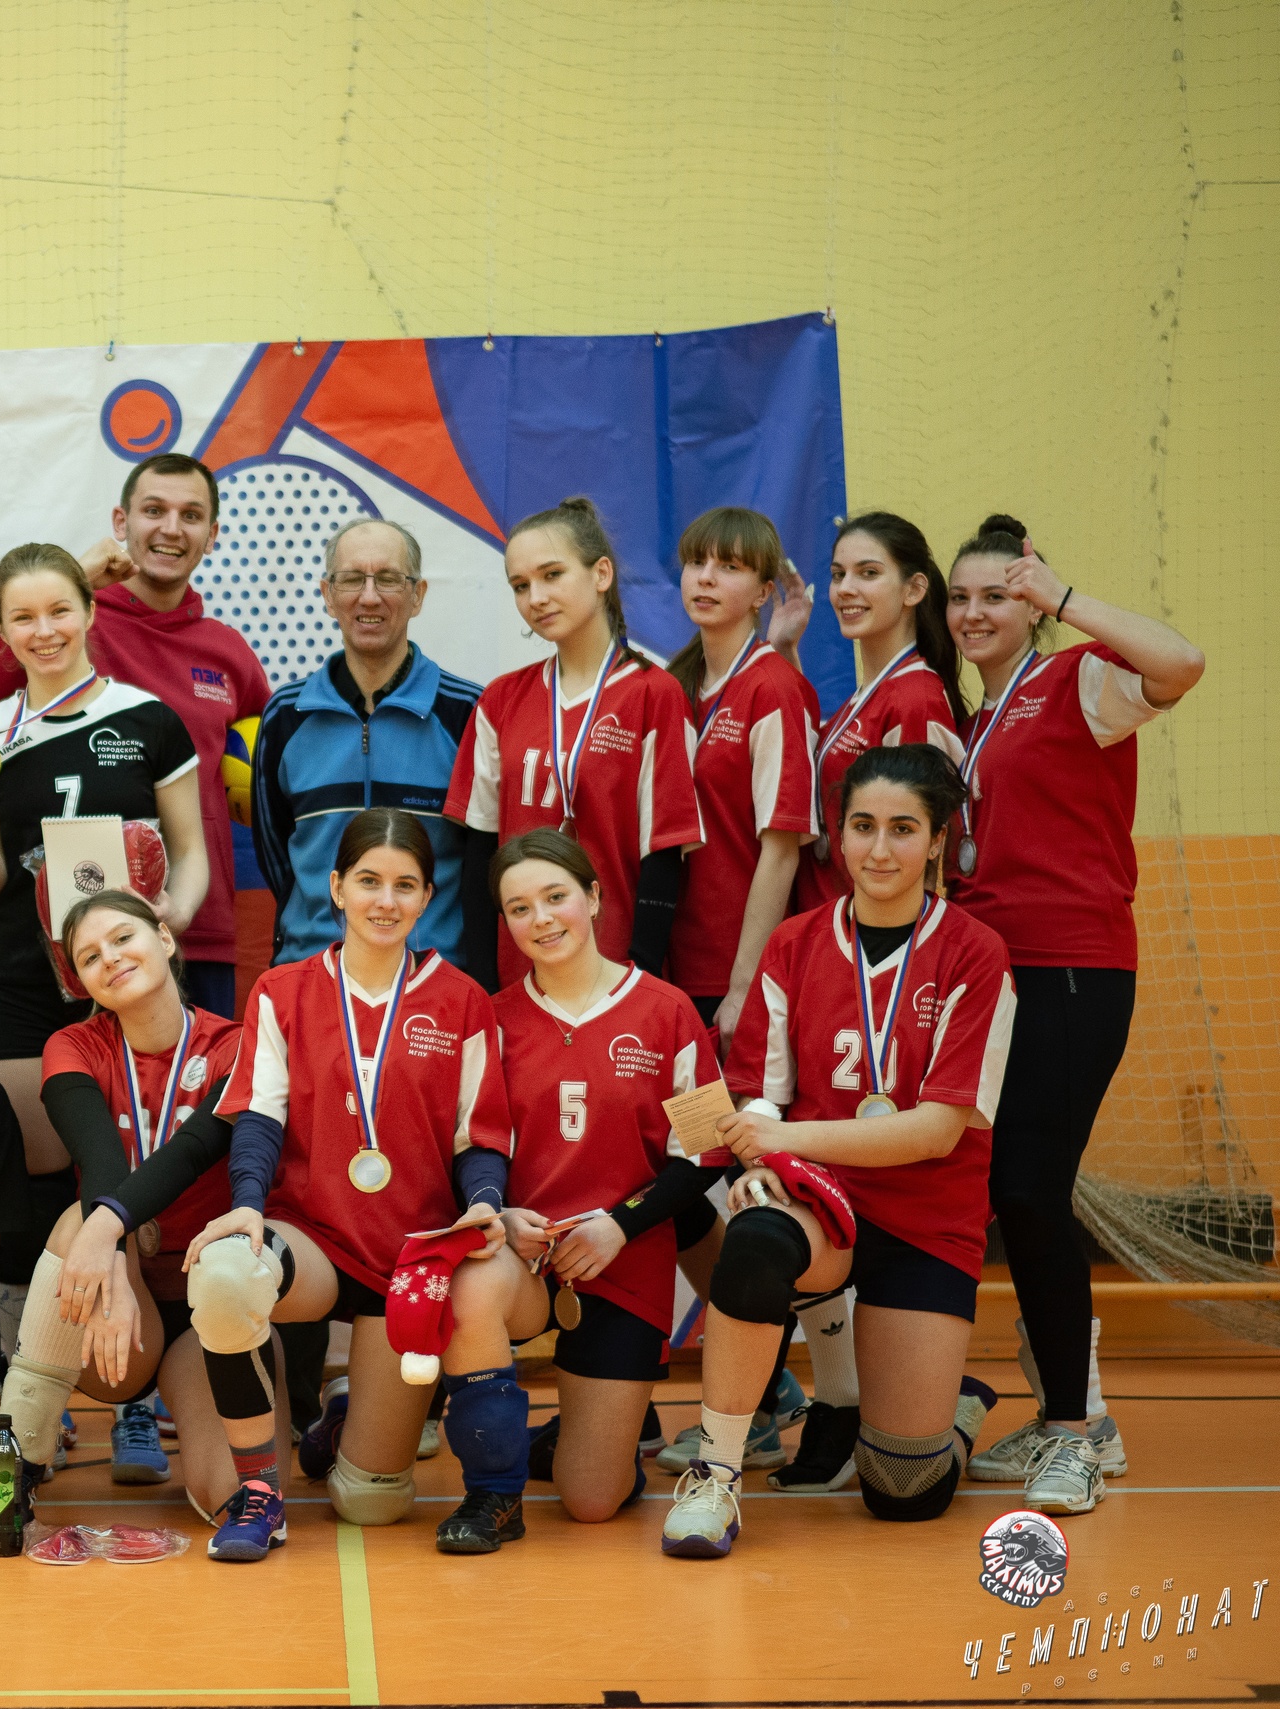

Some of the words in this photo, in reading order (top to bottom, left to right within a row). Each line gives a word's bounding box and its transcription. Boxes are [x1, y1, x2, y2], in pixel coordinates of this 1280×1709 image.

[521, 748, 567, 808] 17
[55, 776, 81, 819] 7
[403, 796, 429, 806] adidas
[410, 1034, 452, 1047] ГОРОДСКОЙ
[408, 1049, 428, 1057] МГПУ
[409, 1041, 455, 1056] УНИВЕРСИТЕТ
[615, 1063, 660, 1076] УНИВЕРСИТЕТ
[615, 1070, 635, 1078] МГПУ
[559, 1081, 587, 1141] 5
[467, 1372, 495, 1383] TORRES
